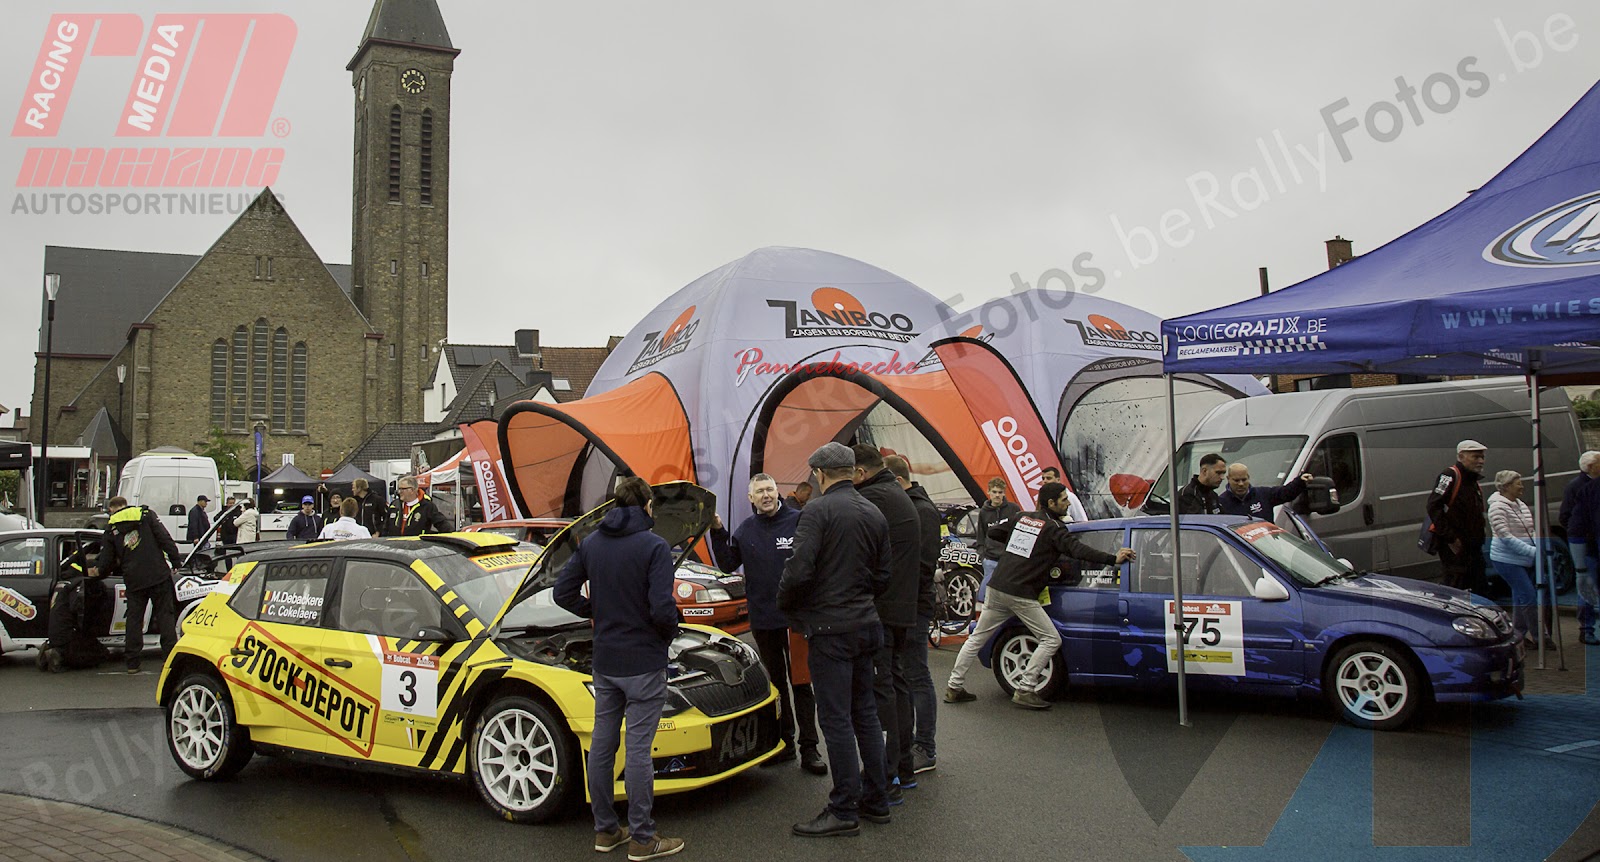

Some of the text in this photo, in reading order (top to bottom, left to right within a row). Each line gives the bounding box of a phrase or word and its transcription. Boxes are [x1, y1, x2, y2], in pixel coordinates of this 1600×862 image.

[766, 299, 914, 338] ZANIBOO
[791, 329, 826, 337] ZAGEN
[843, 329, 876, 337] BOREN
[1063, 318, 1159, 345] ZANIBOO
[1179, 346, 1237, 355] RECLAMEMAKERS
[178, 586, 215, 598] STROOBAN
[278, 605, 317, 621] Cokelaere
[1182, 618, 1221, 647] 75
[398, 670, 417, 707] 3
